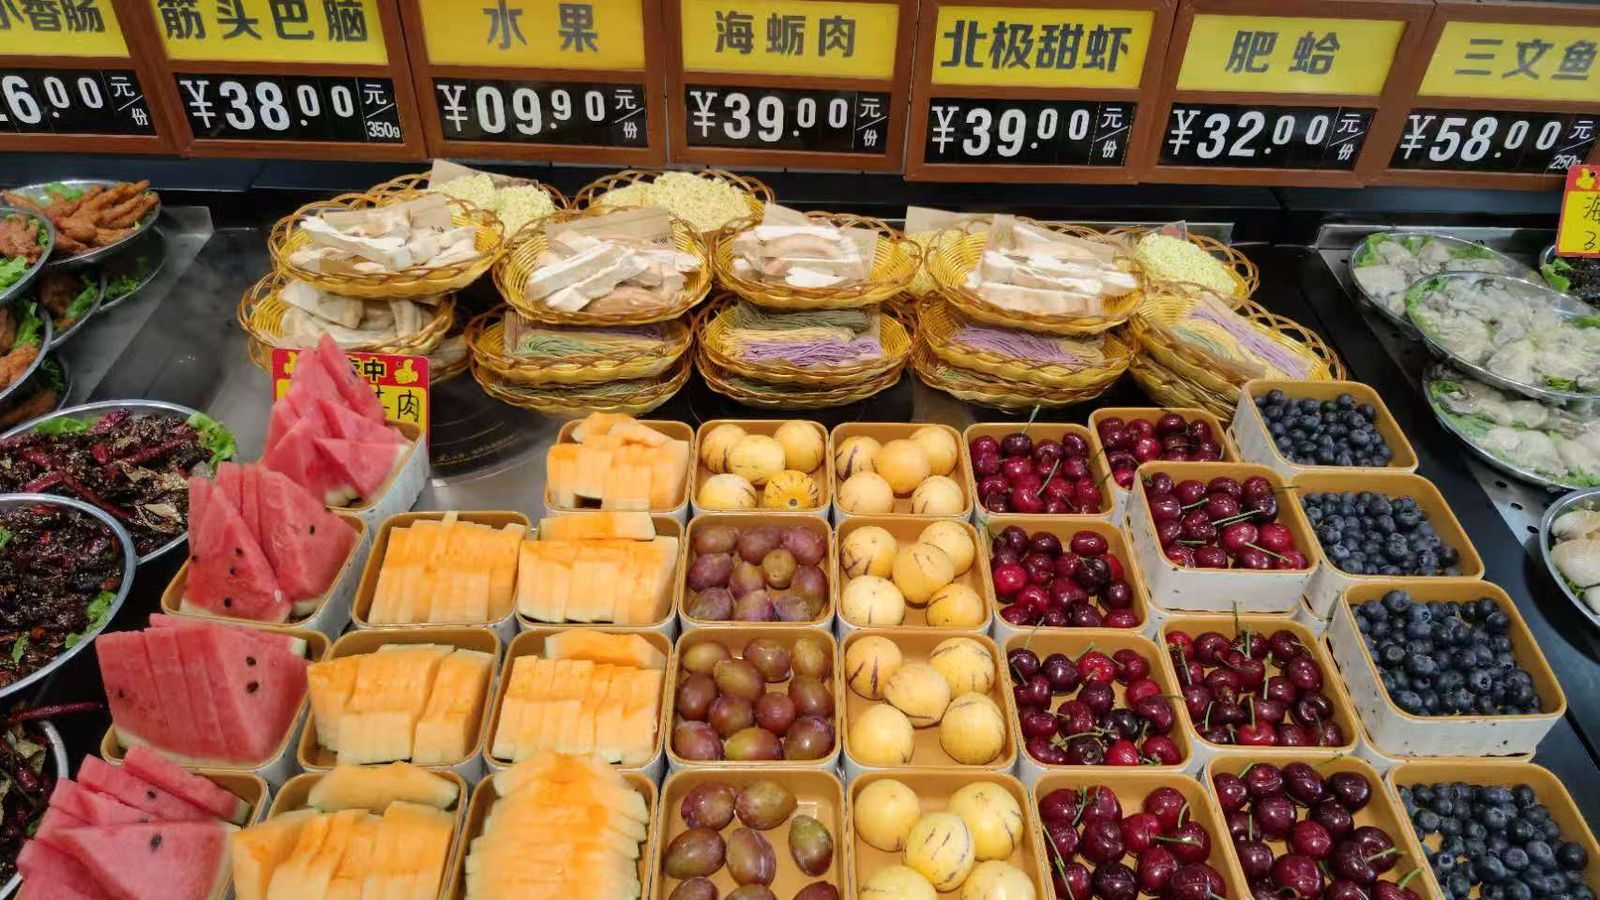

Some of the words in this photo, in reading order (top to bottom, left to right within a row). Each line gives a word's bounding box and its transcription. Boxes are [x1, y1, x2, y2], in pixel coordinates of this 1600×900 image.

[159, 0, 367, 42] 筋头巴脑
[483, 0, 599, 52] 水果
[715, 11, 856, 57] 海蛎肉
[941, 20, 1133, 72] 北极甜虾
[1225, 30, 1341, 75] 肥蛤
[1454, 39, 1598, 80] 三文鱼
[0, 75, 104, 124] 6.00
[366, 121, 400, 139] 350g
